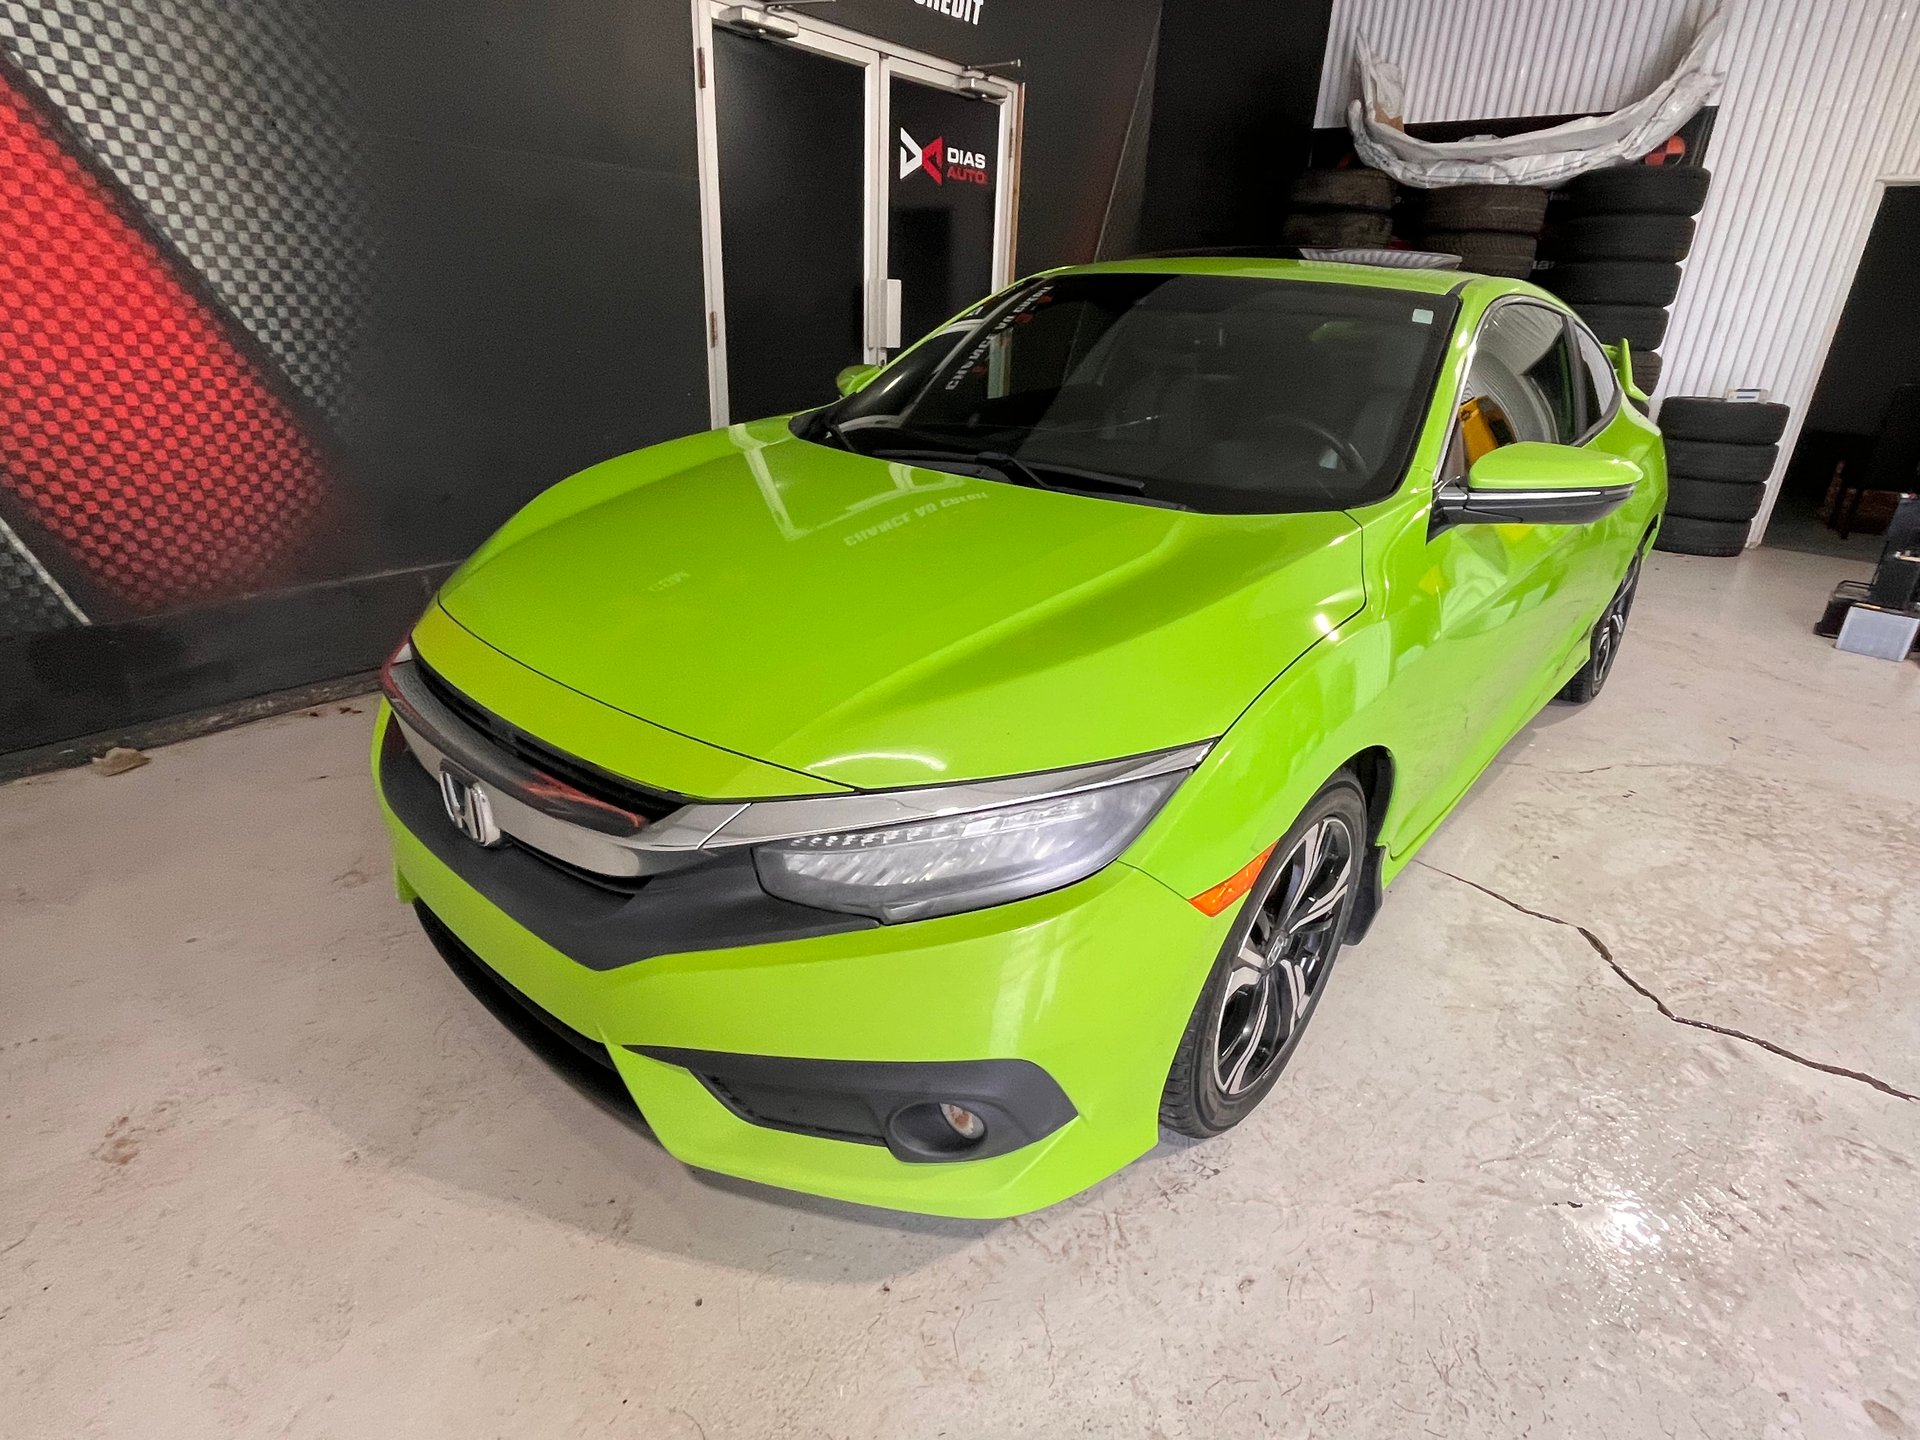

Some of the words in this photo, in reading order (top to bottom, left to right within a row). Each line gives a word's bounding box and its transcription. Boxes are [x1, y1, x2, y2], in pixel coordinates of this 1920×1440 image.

[914, 0, 984, 25] EDIT
[947, 147, 986, 169] DIAS
[947, 166, 988, 185] AUTO
